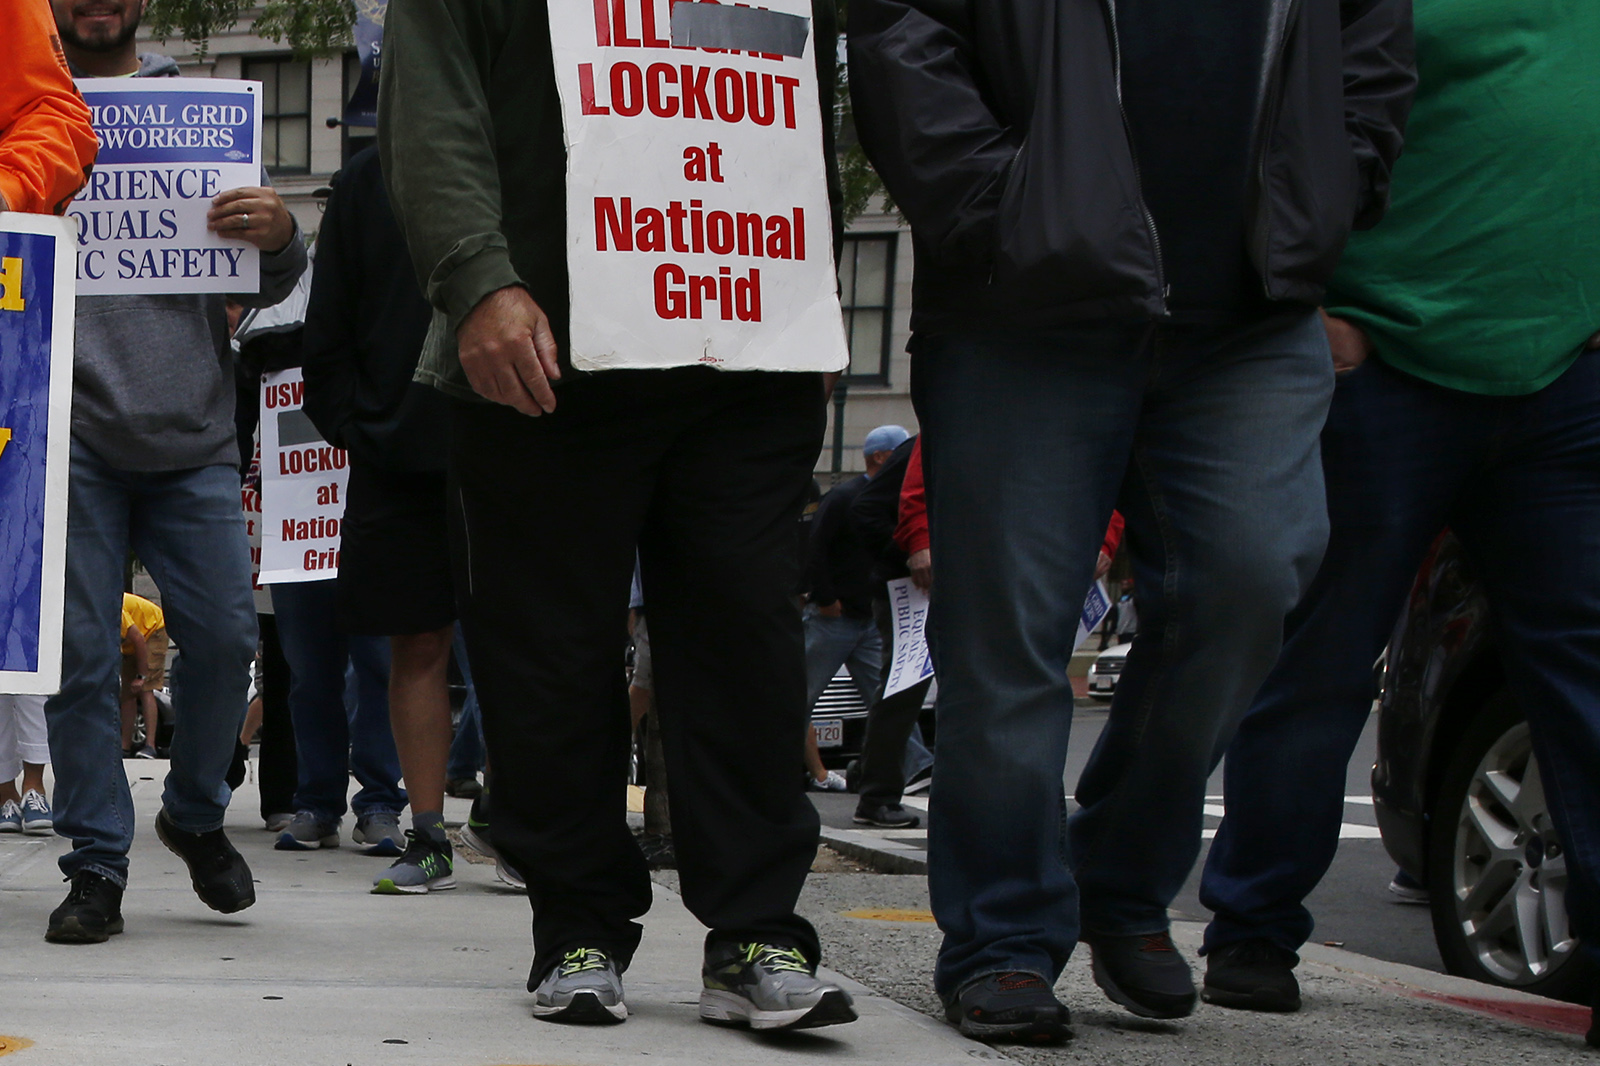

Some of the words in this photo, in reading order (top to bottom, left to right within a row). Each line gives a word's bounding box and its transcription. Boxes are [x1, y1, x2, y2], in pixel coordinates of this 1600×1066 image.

[578, 61, 800, 129] LOCKOUT
[181, 104, 248, 126] GRID
[683, 142, 724, 183] at
[594, 196, 805, 261] National
[118, 248, 245, 279] SAFETY
[653, 263, 761, 322] Grid
[279, 446, 350, 475] LOCKO
[316, 482, 339, 505] at
[282, 515, 342, 541] Natio
[894, 585, 911, 639] PUBLIC
